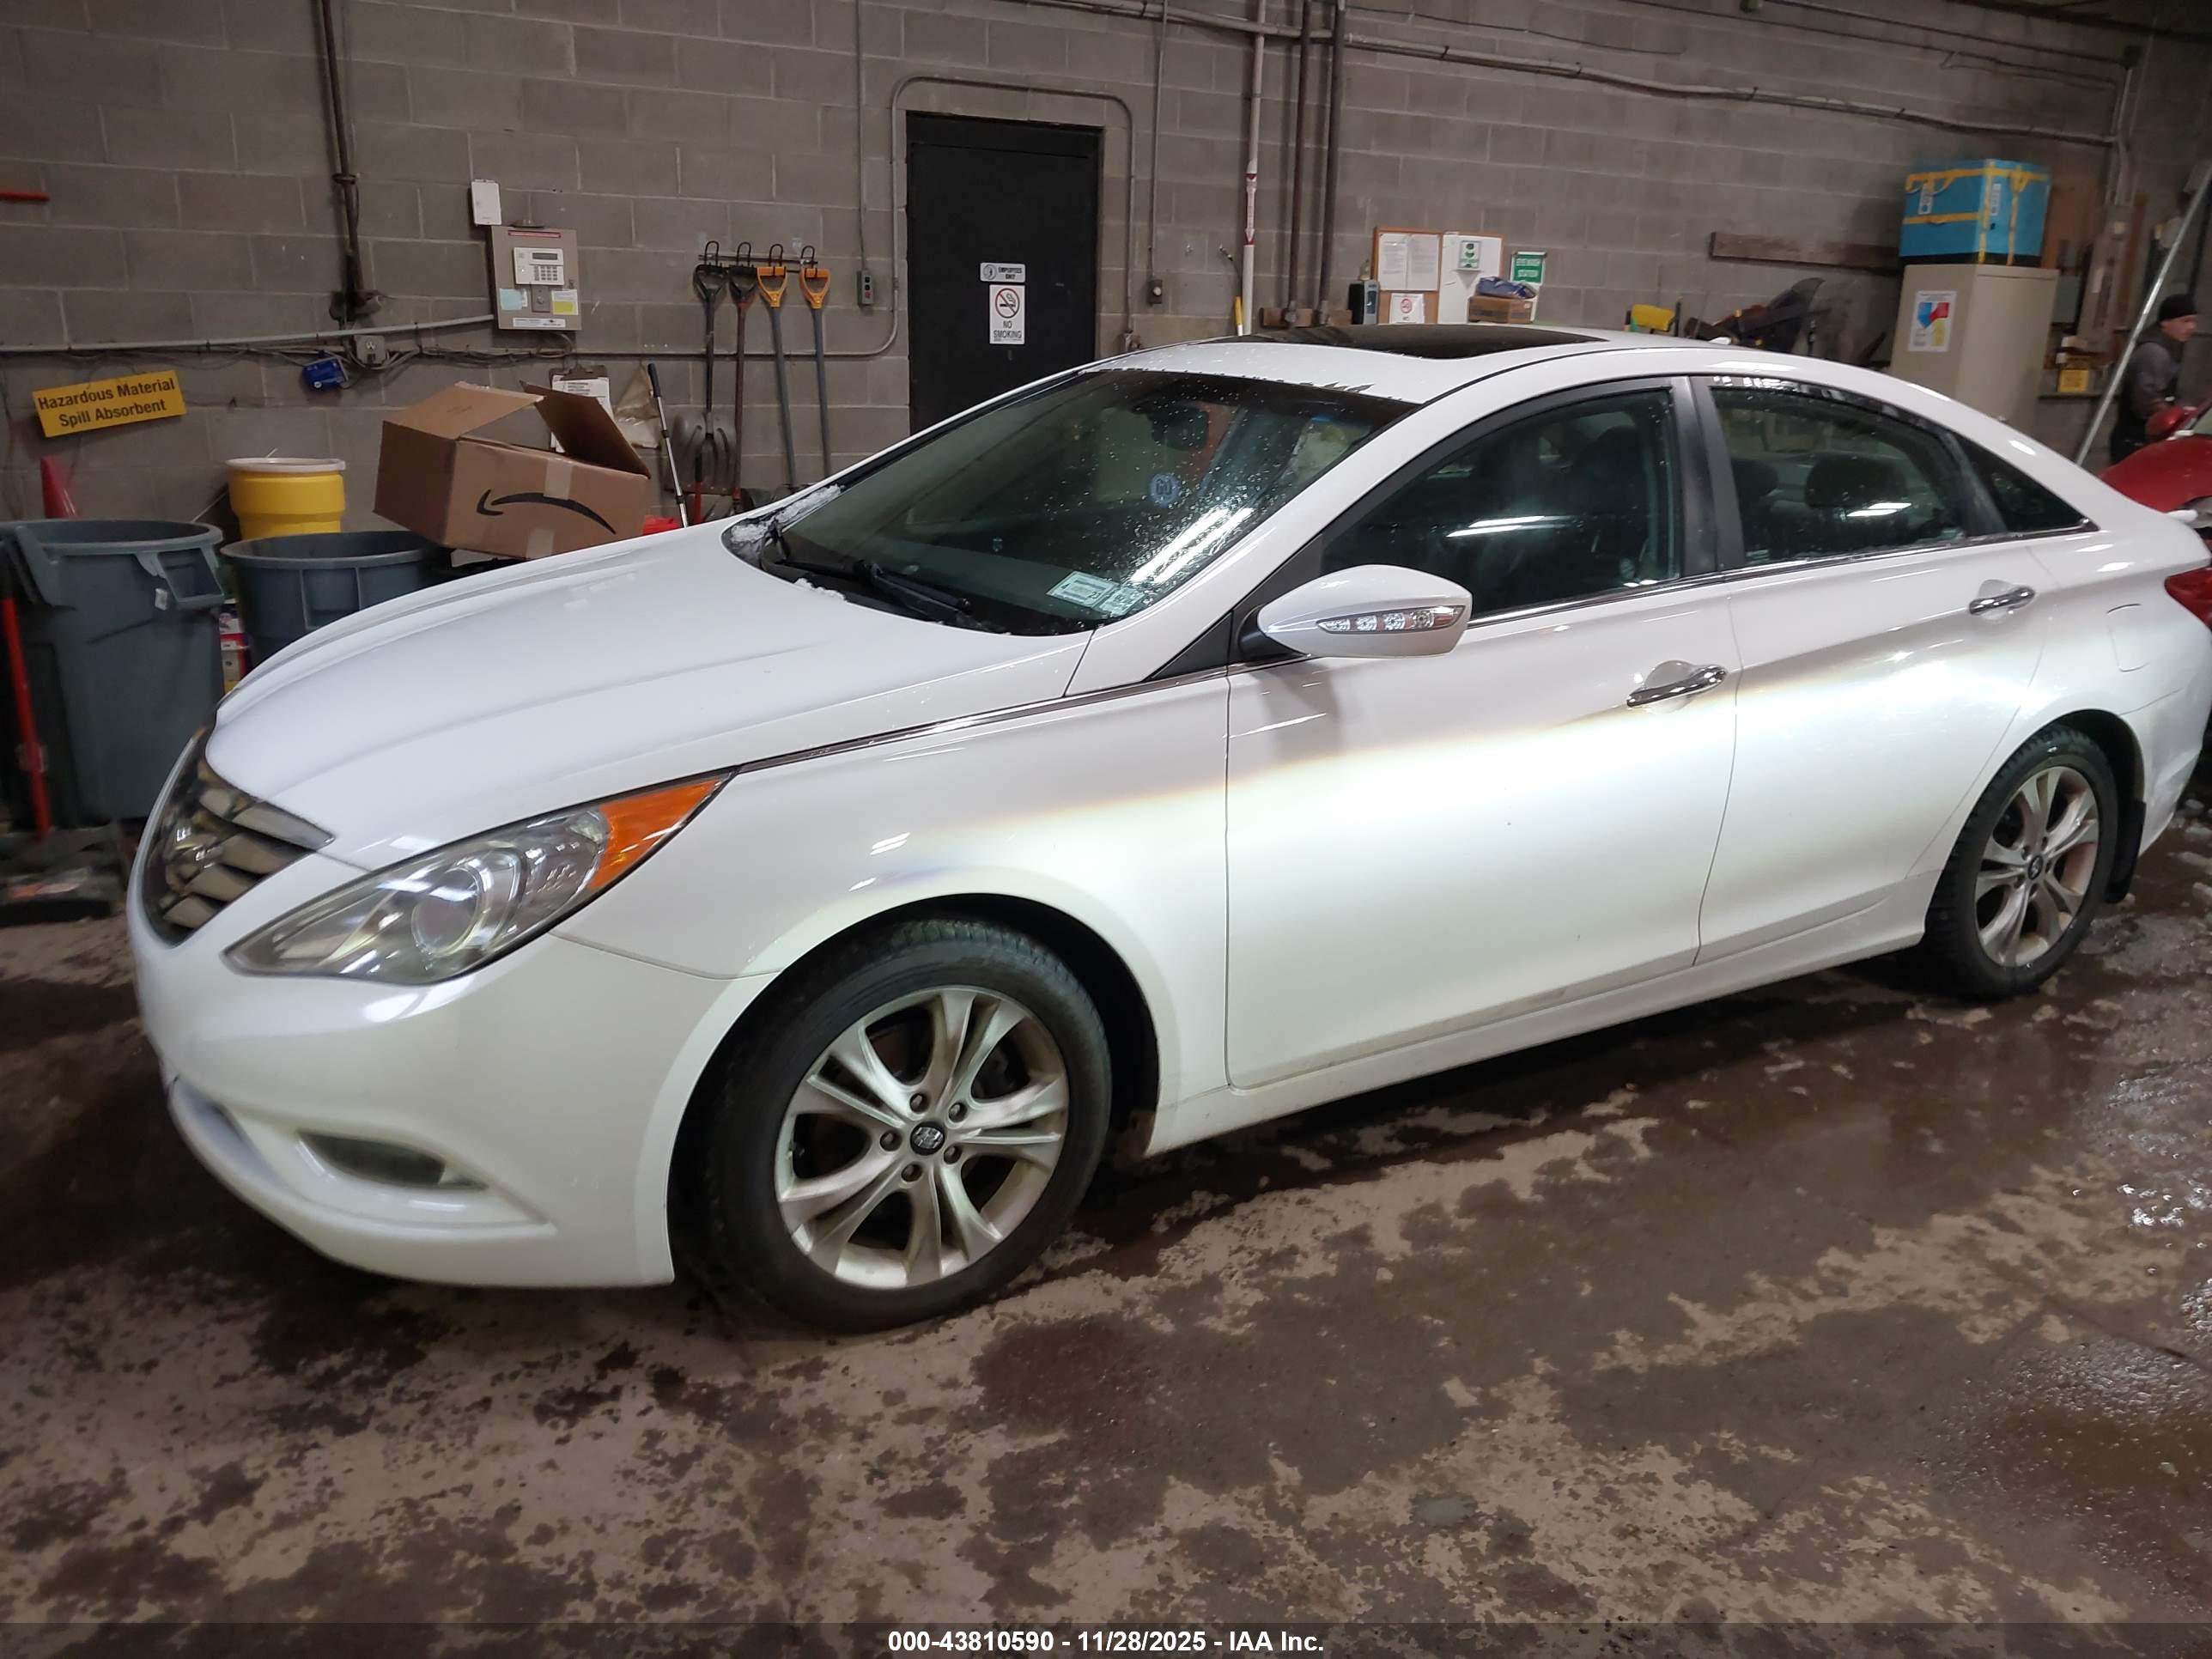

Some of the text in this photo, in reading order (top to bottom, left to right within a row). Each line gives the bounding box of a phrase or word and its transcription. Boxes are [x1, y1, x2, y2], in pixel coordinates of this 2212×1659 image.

[1002, 320, 1012, 329] NO
[993, 330, 1023, 339] SMOKING
[38, 378, 175, 410] Hazardous Material
[59, 399, 167, 428] Spill Absorbent
